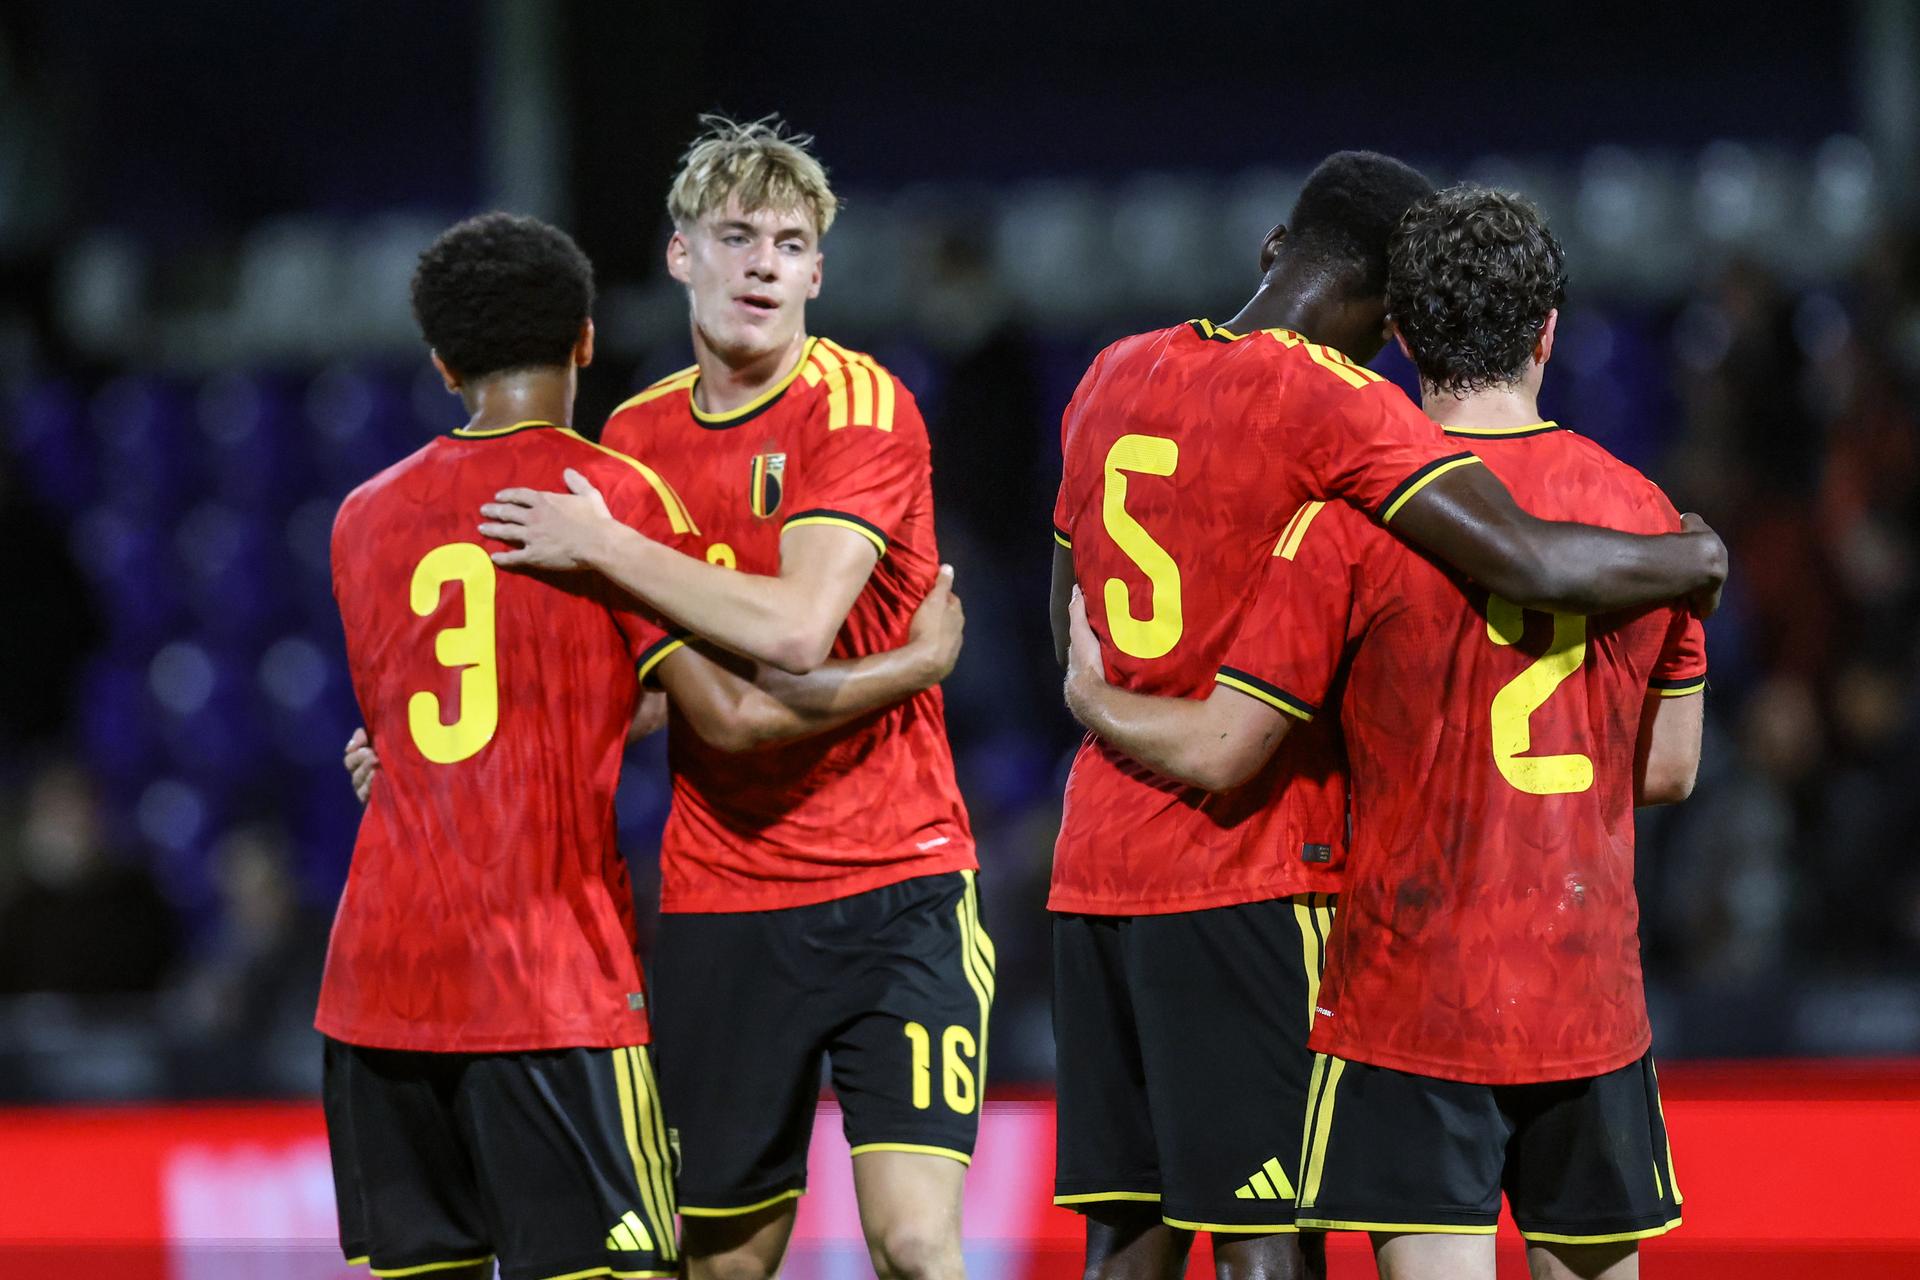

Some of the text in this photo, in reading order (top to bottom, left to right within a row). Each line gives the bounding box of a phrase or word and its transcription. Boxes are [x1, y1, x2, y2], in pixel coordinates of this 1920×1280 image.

[1103, 434, 1183, 659] 5
[408, 542, 498, 764] 3
[1486, 593, 1594, 795] 2
[904, 1021, 977, 1115] 16
